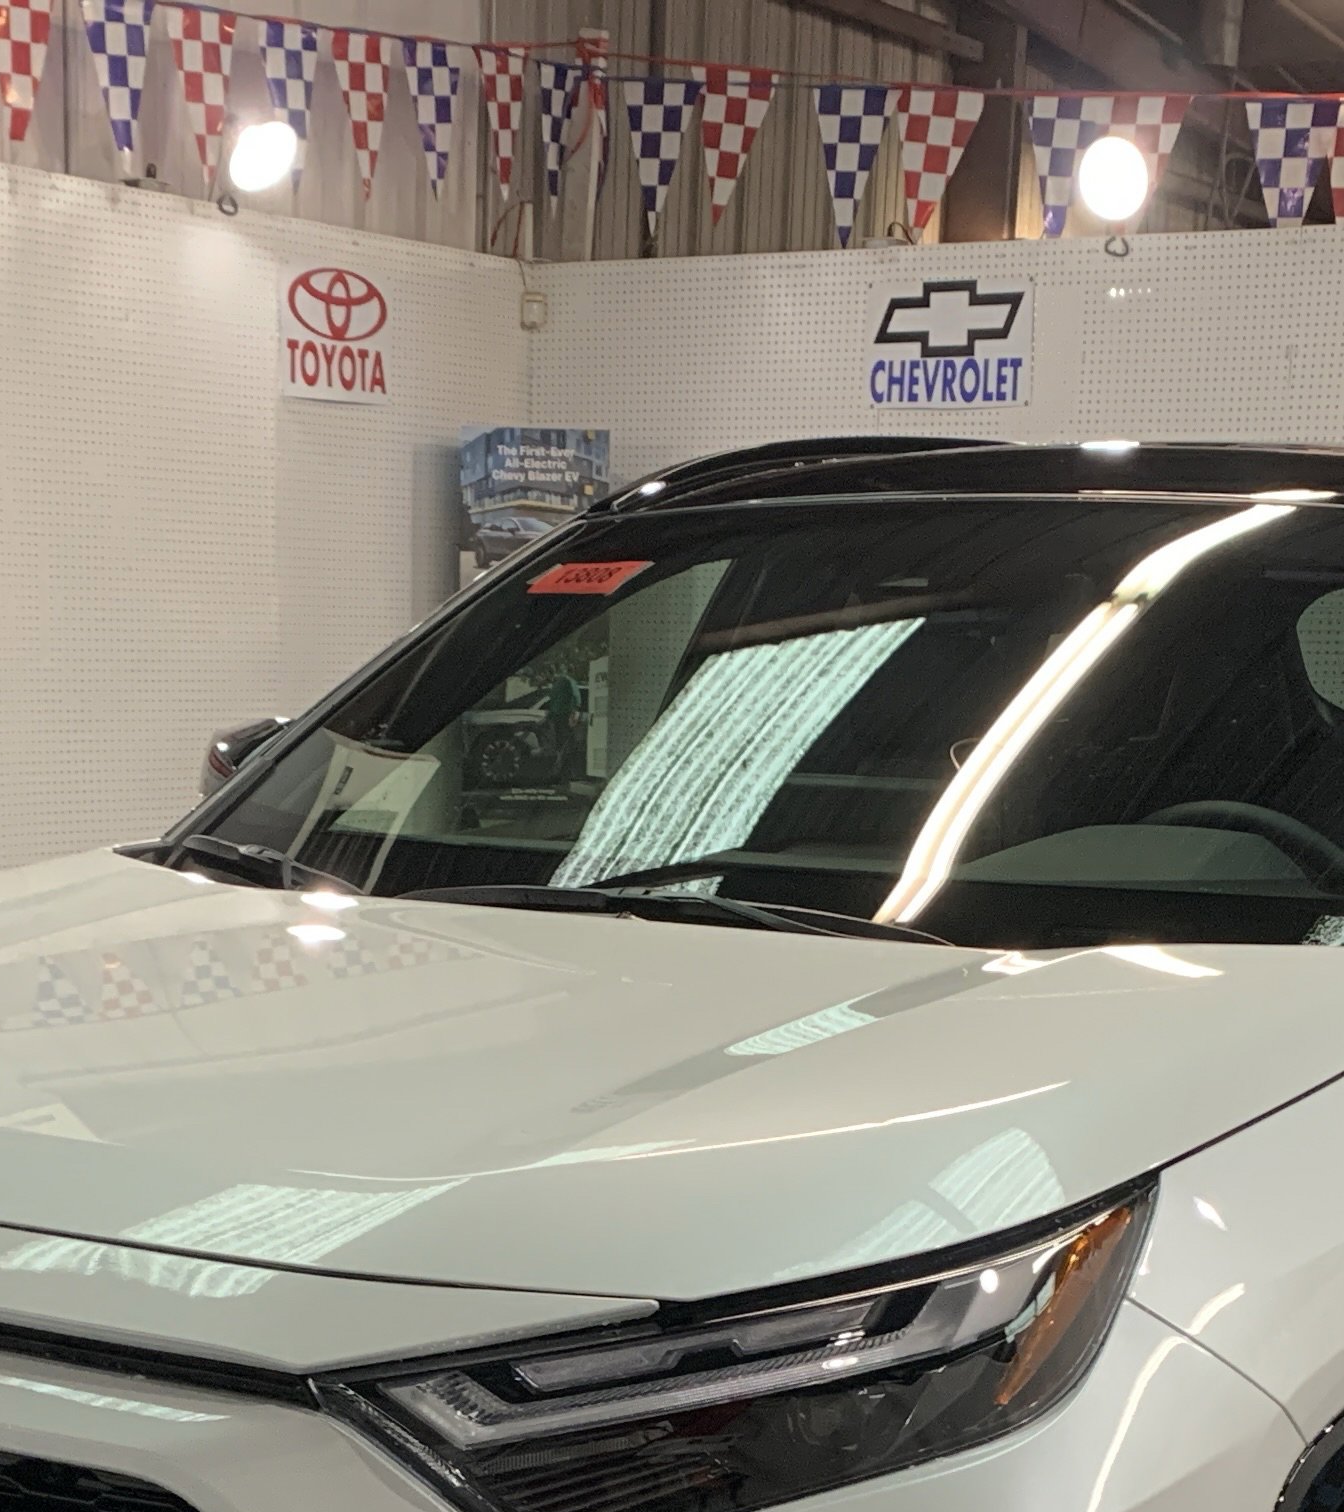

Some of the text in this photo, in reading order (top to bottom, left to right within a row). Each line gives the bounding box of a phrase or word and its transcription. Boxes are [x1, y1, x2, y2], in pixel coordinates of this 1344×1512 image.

[287, 338, 388, 395] TOYOTA
[870, 357, 1023, 404] CHEVROLET
[496, 444, 518, 456] The
[505, 457, 567, 469] All-Electric
[492, 469, 580, 482] Chevy Blazer EV
